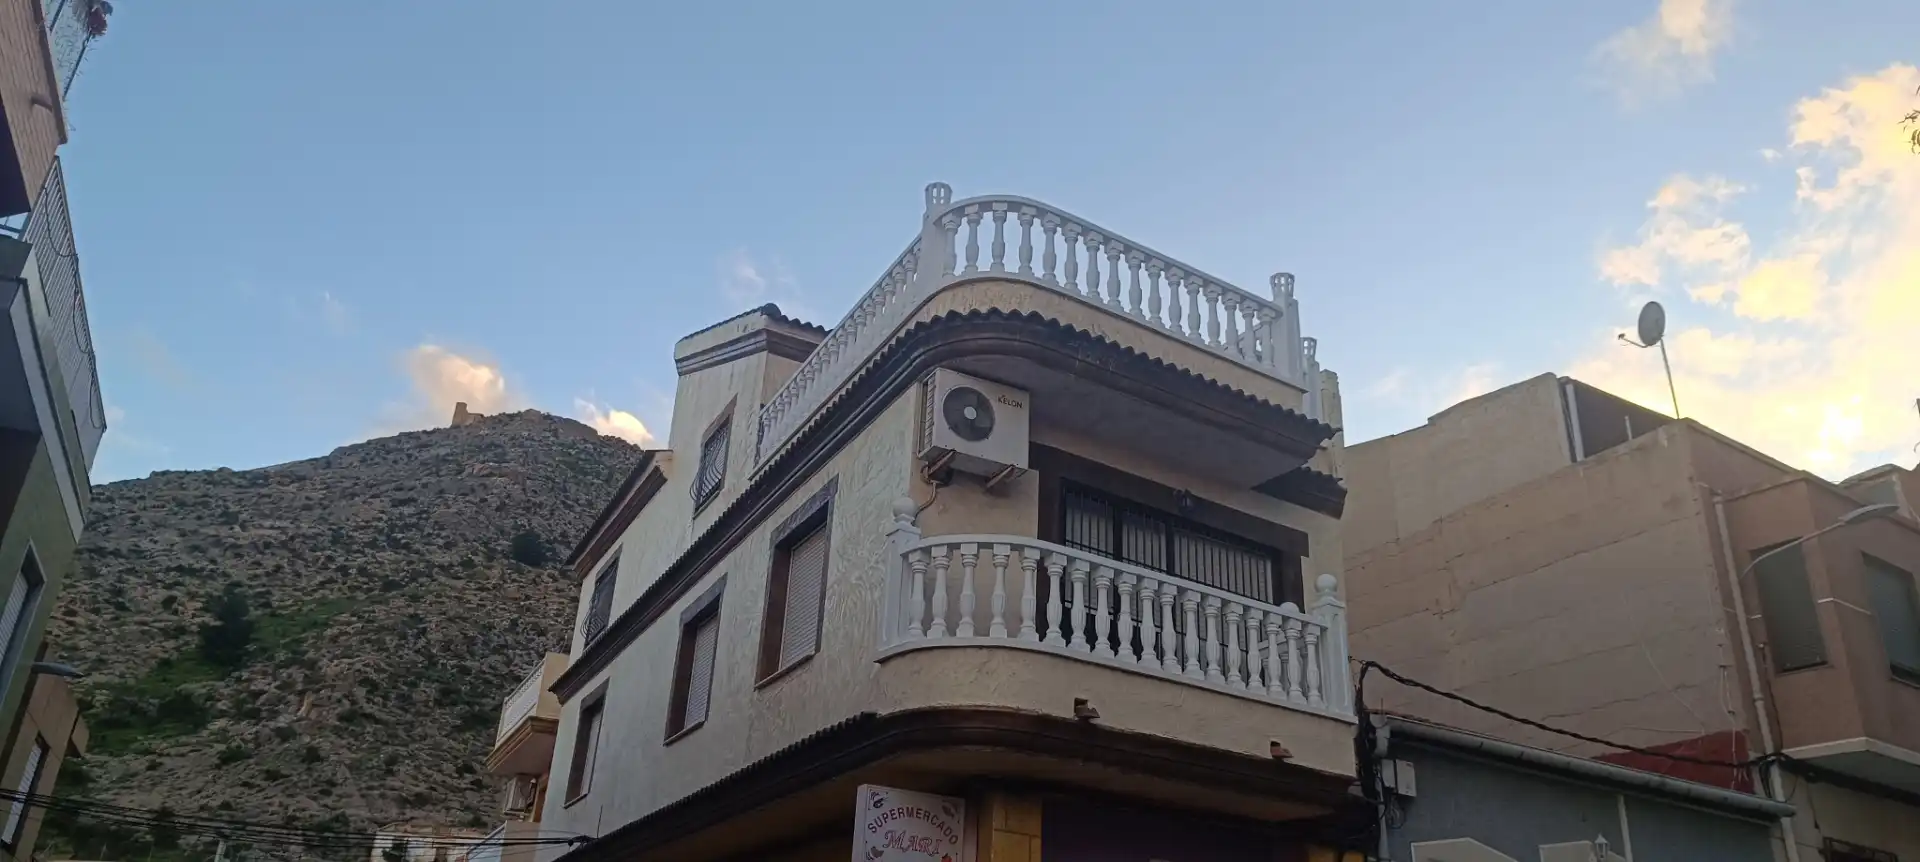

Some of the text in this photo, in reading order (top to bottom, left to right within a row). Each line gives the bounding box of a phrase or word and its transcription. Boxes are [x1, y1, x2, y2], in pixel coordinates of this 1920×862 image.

[998, 395, 1022, 408] KELON
[867, 806, 958, 845] SUPERMERCADO
[882, 829, 942, 857] MARI
